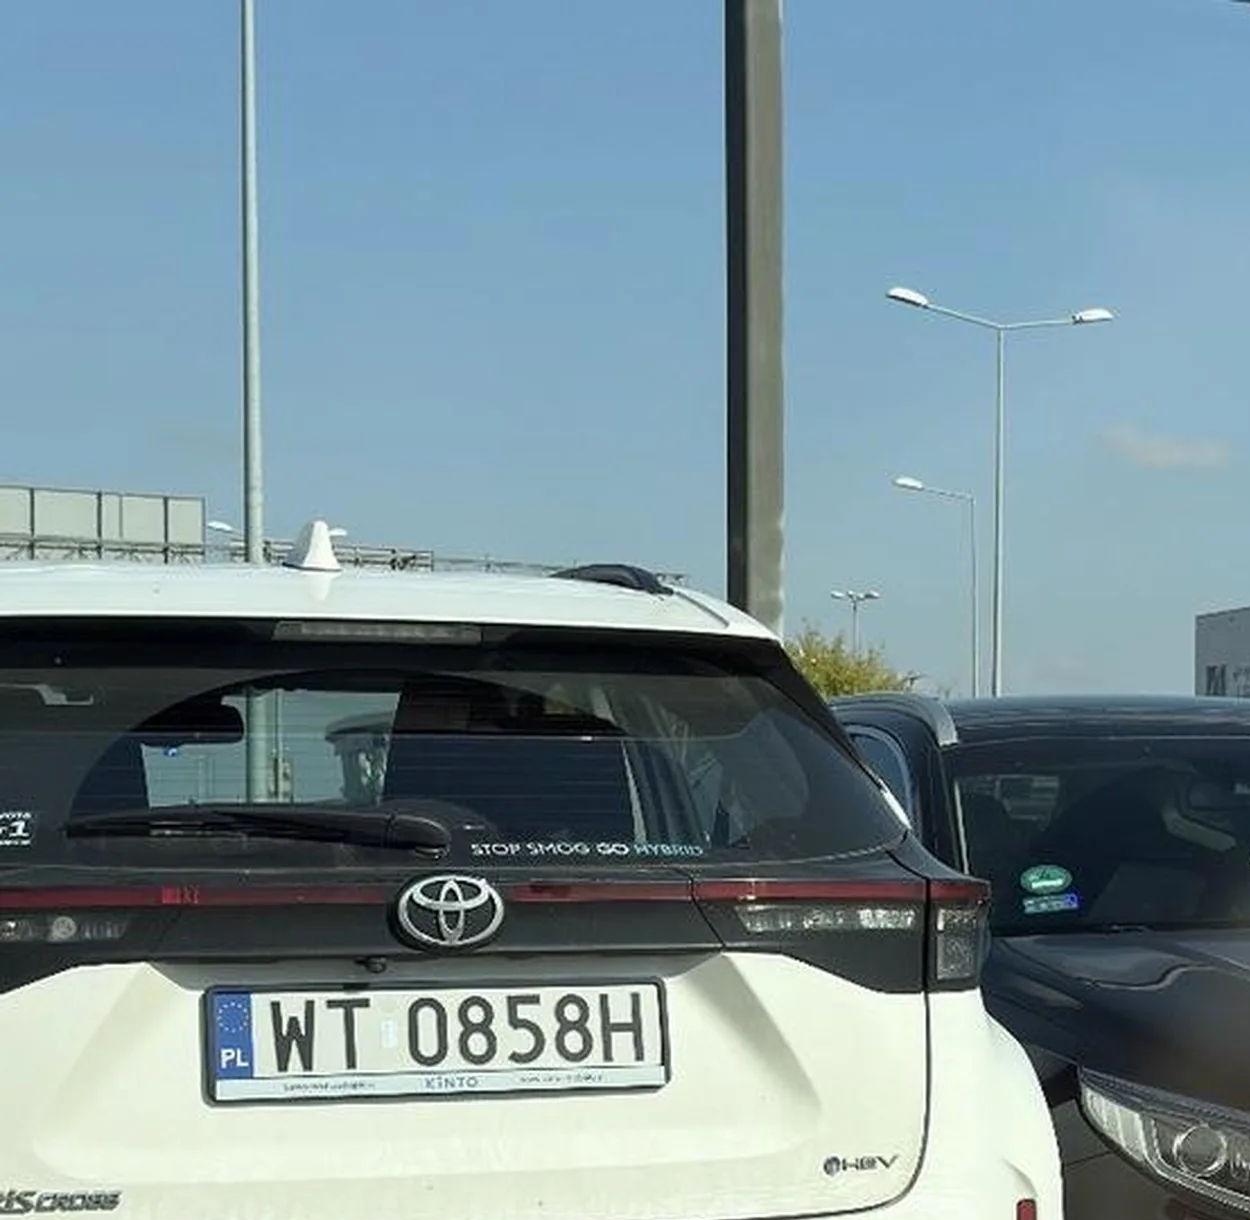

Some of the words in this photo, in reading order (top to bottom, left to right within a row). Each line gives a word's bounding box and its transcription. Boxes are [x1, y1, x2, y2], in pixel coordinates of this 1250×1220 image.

[471, 843, 521, 856] STOP
[526, 843, 591, 856] SMOG
[596, 842, 630, 855] GO
[634, 843, 704, 857] HYBRID
[270, 998, 370, 1073] WT
[407, 991, 648, 1067] 0858H
[220, 1049, 249, 1068] PL
